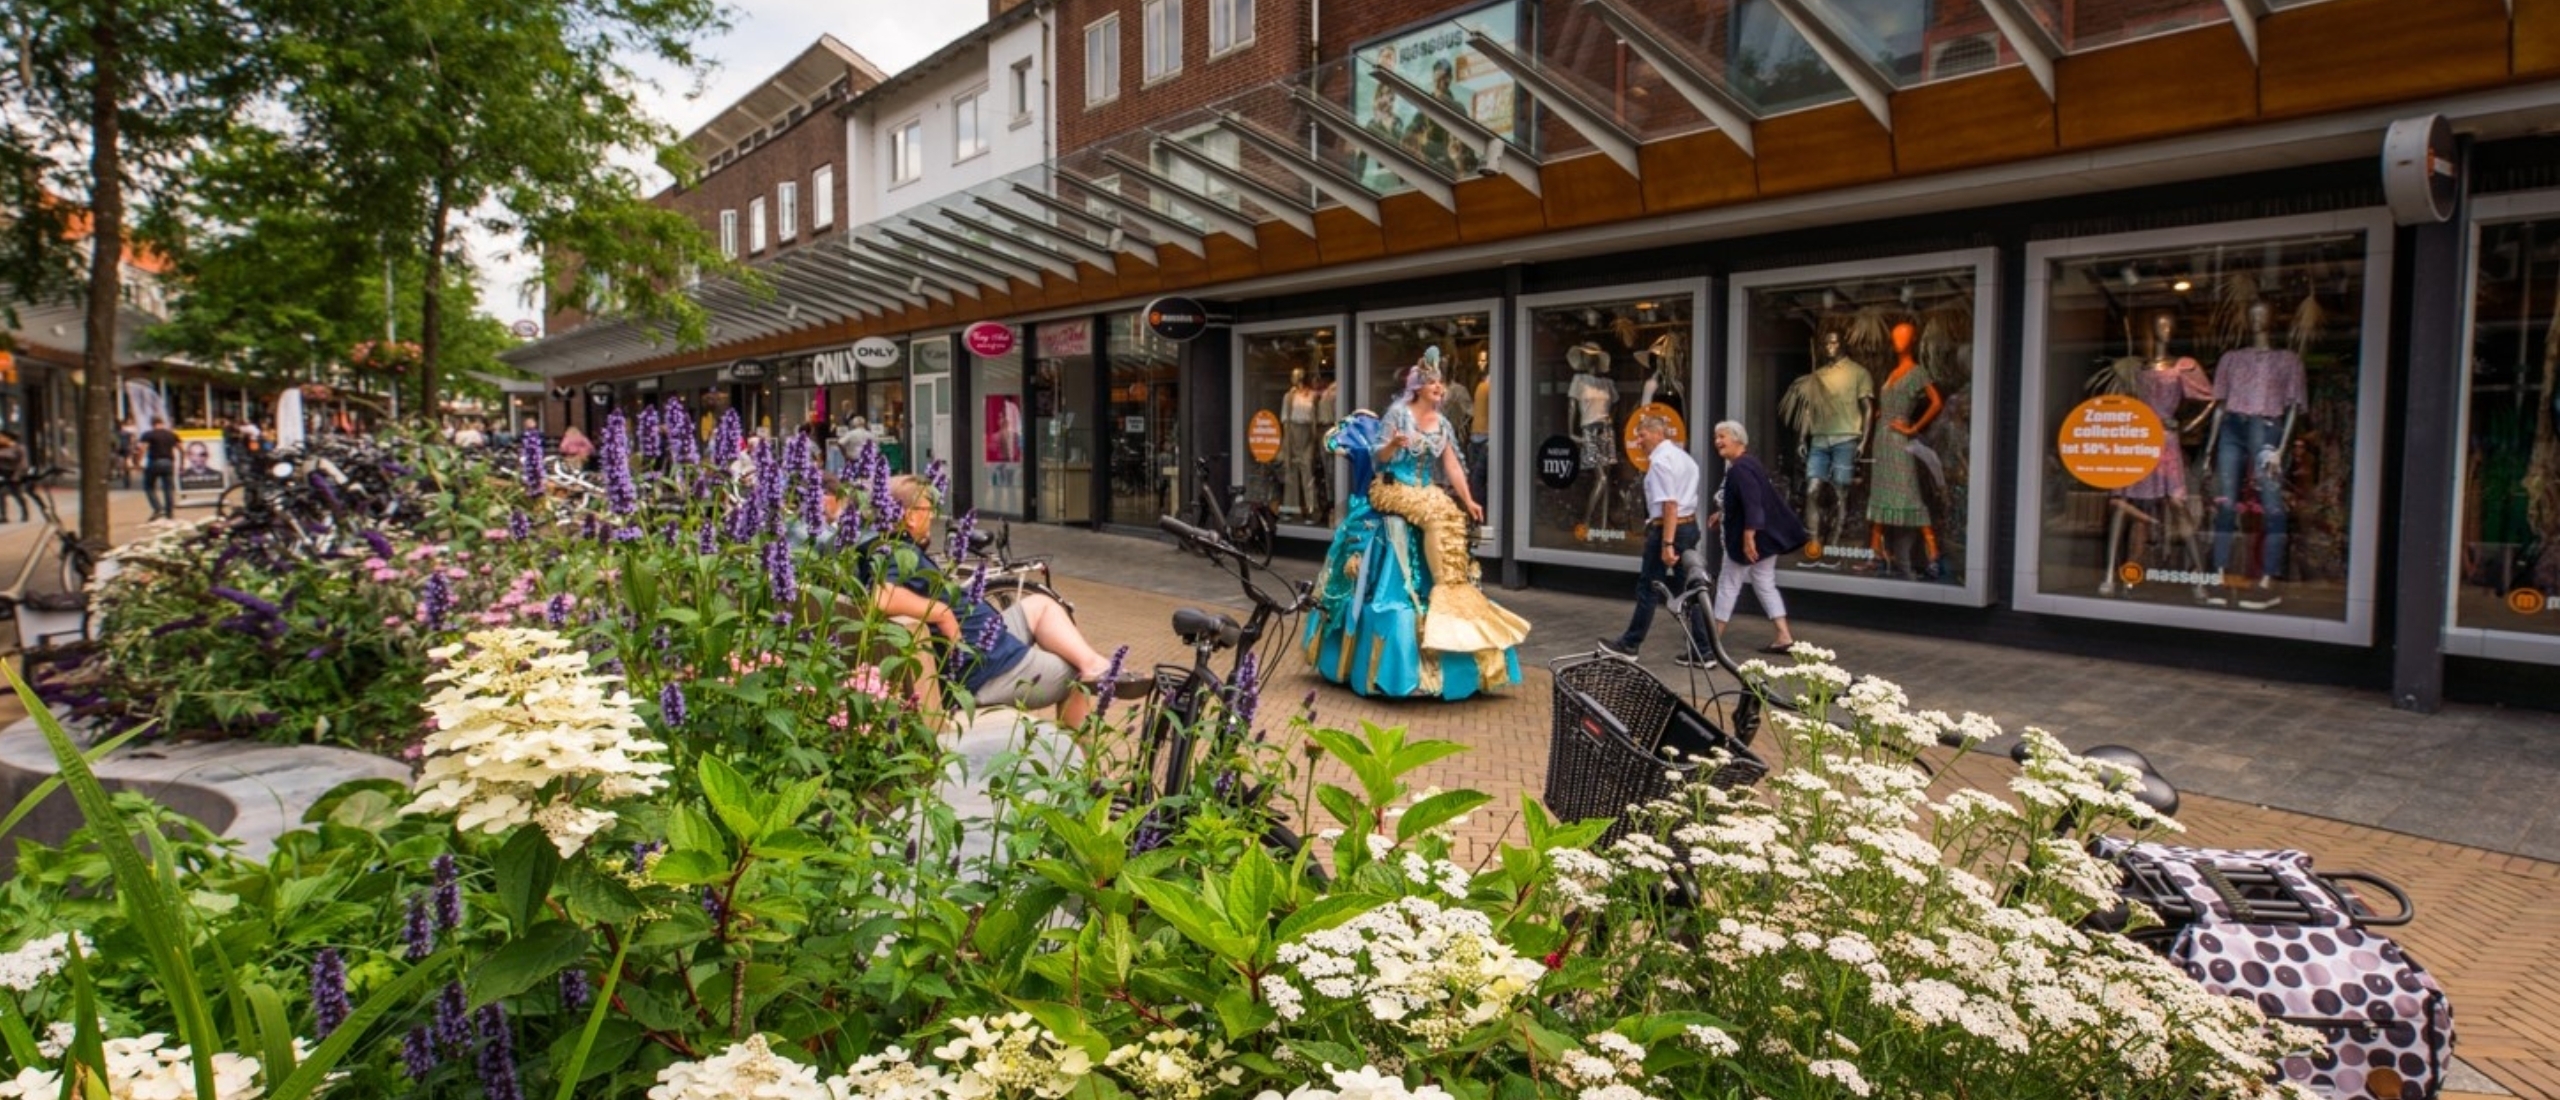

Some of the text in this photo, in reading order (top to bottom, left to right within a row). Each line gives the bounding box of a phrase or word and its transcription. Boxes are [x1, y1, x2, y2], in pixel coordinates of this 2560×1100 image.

[857, 347, 894, 357] ONLY
[813, 351, 858, 385] ONLY
[2084, 409, 2139, 422] Zomer-
[2073, 424, 2149, 438] collecties
[2061, 443, 2160, 458] tot 50% korting
